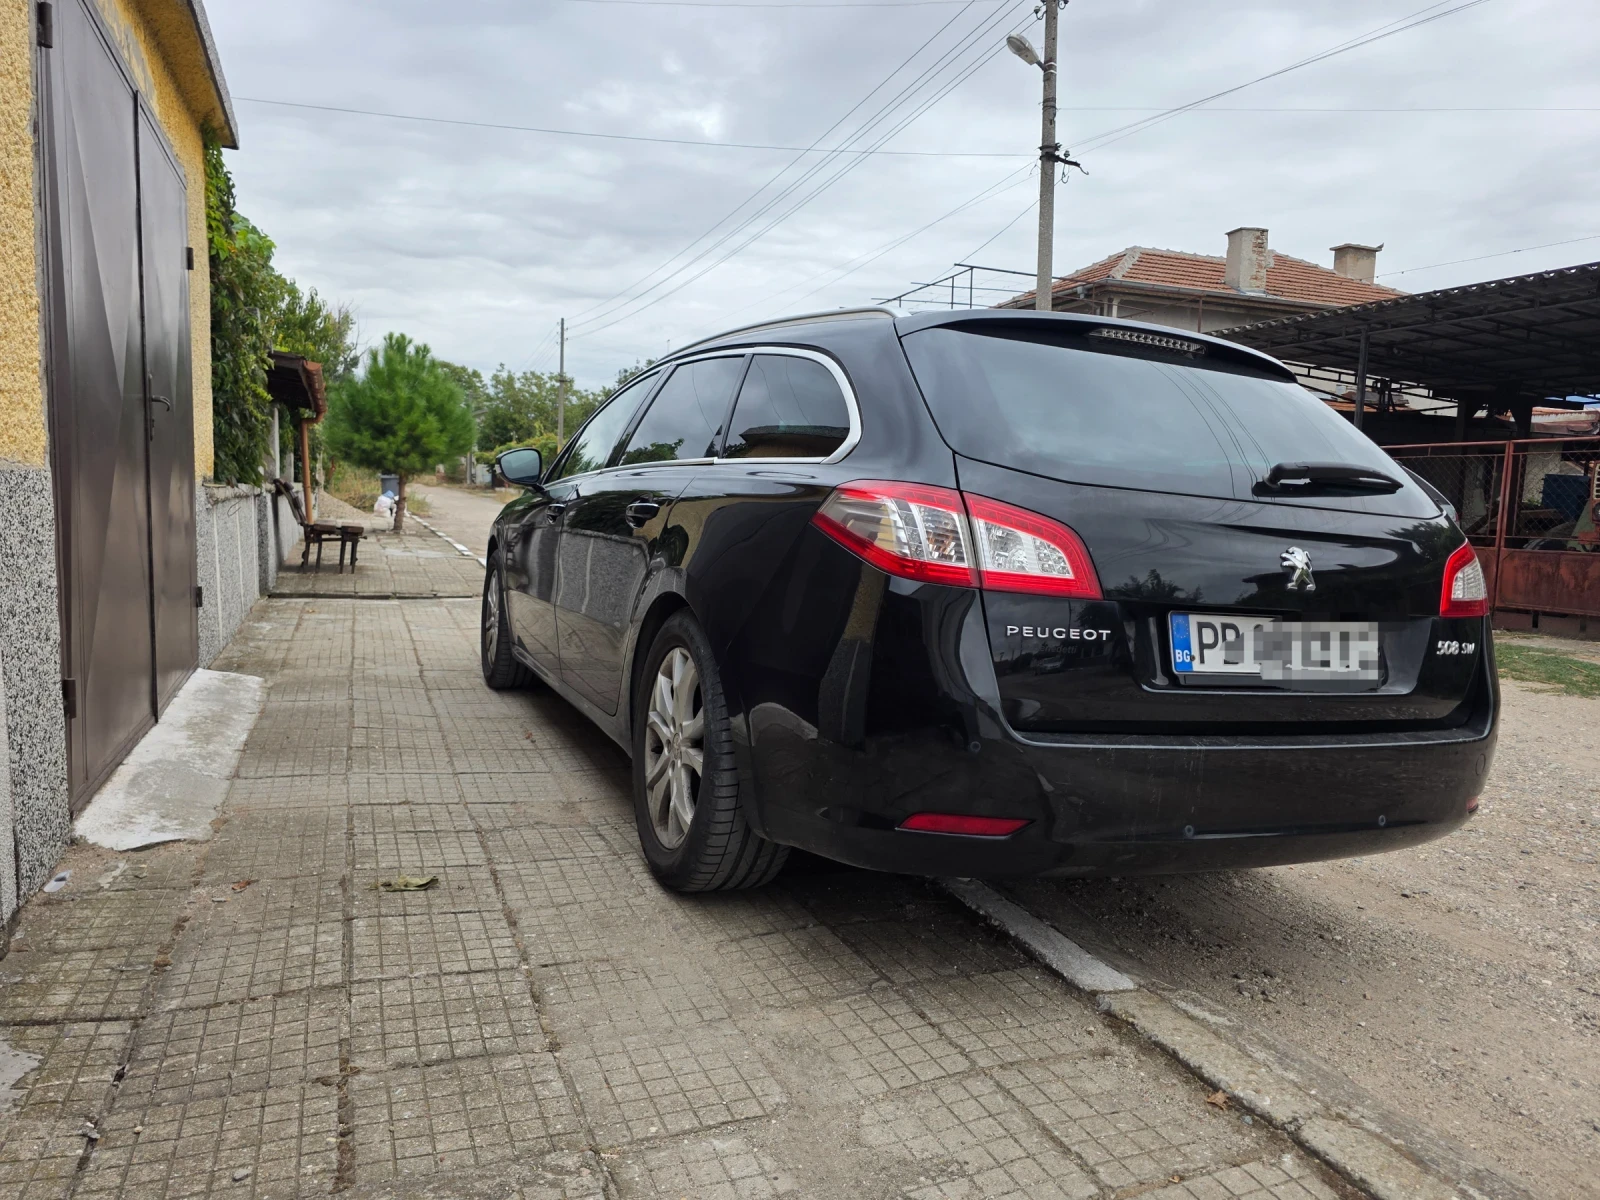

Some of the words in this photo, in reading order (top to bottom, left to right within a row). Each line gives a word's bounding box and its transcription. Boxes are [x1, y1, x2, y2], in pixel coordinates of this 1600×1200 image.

[1006, 625, 1111, 641] PEUGEOT
[1436, 640, 1460, 655] 508
[1461, 642, 1475, 654] SW
[1175, 649, 1191, 662] BG
